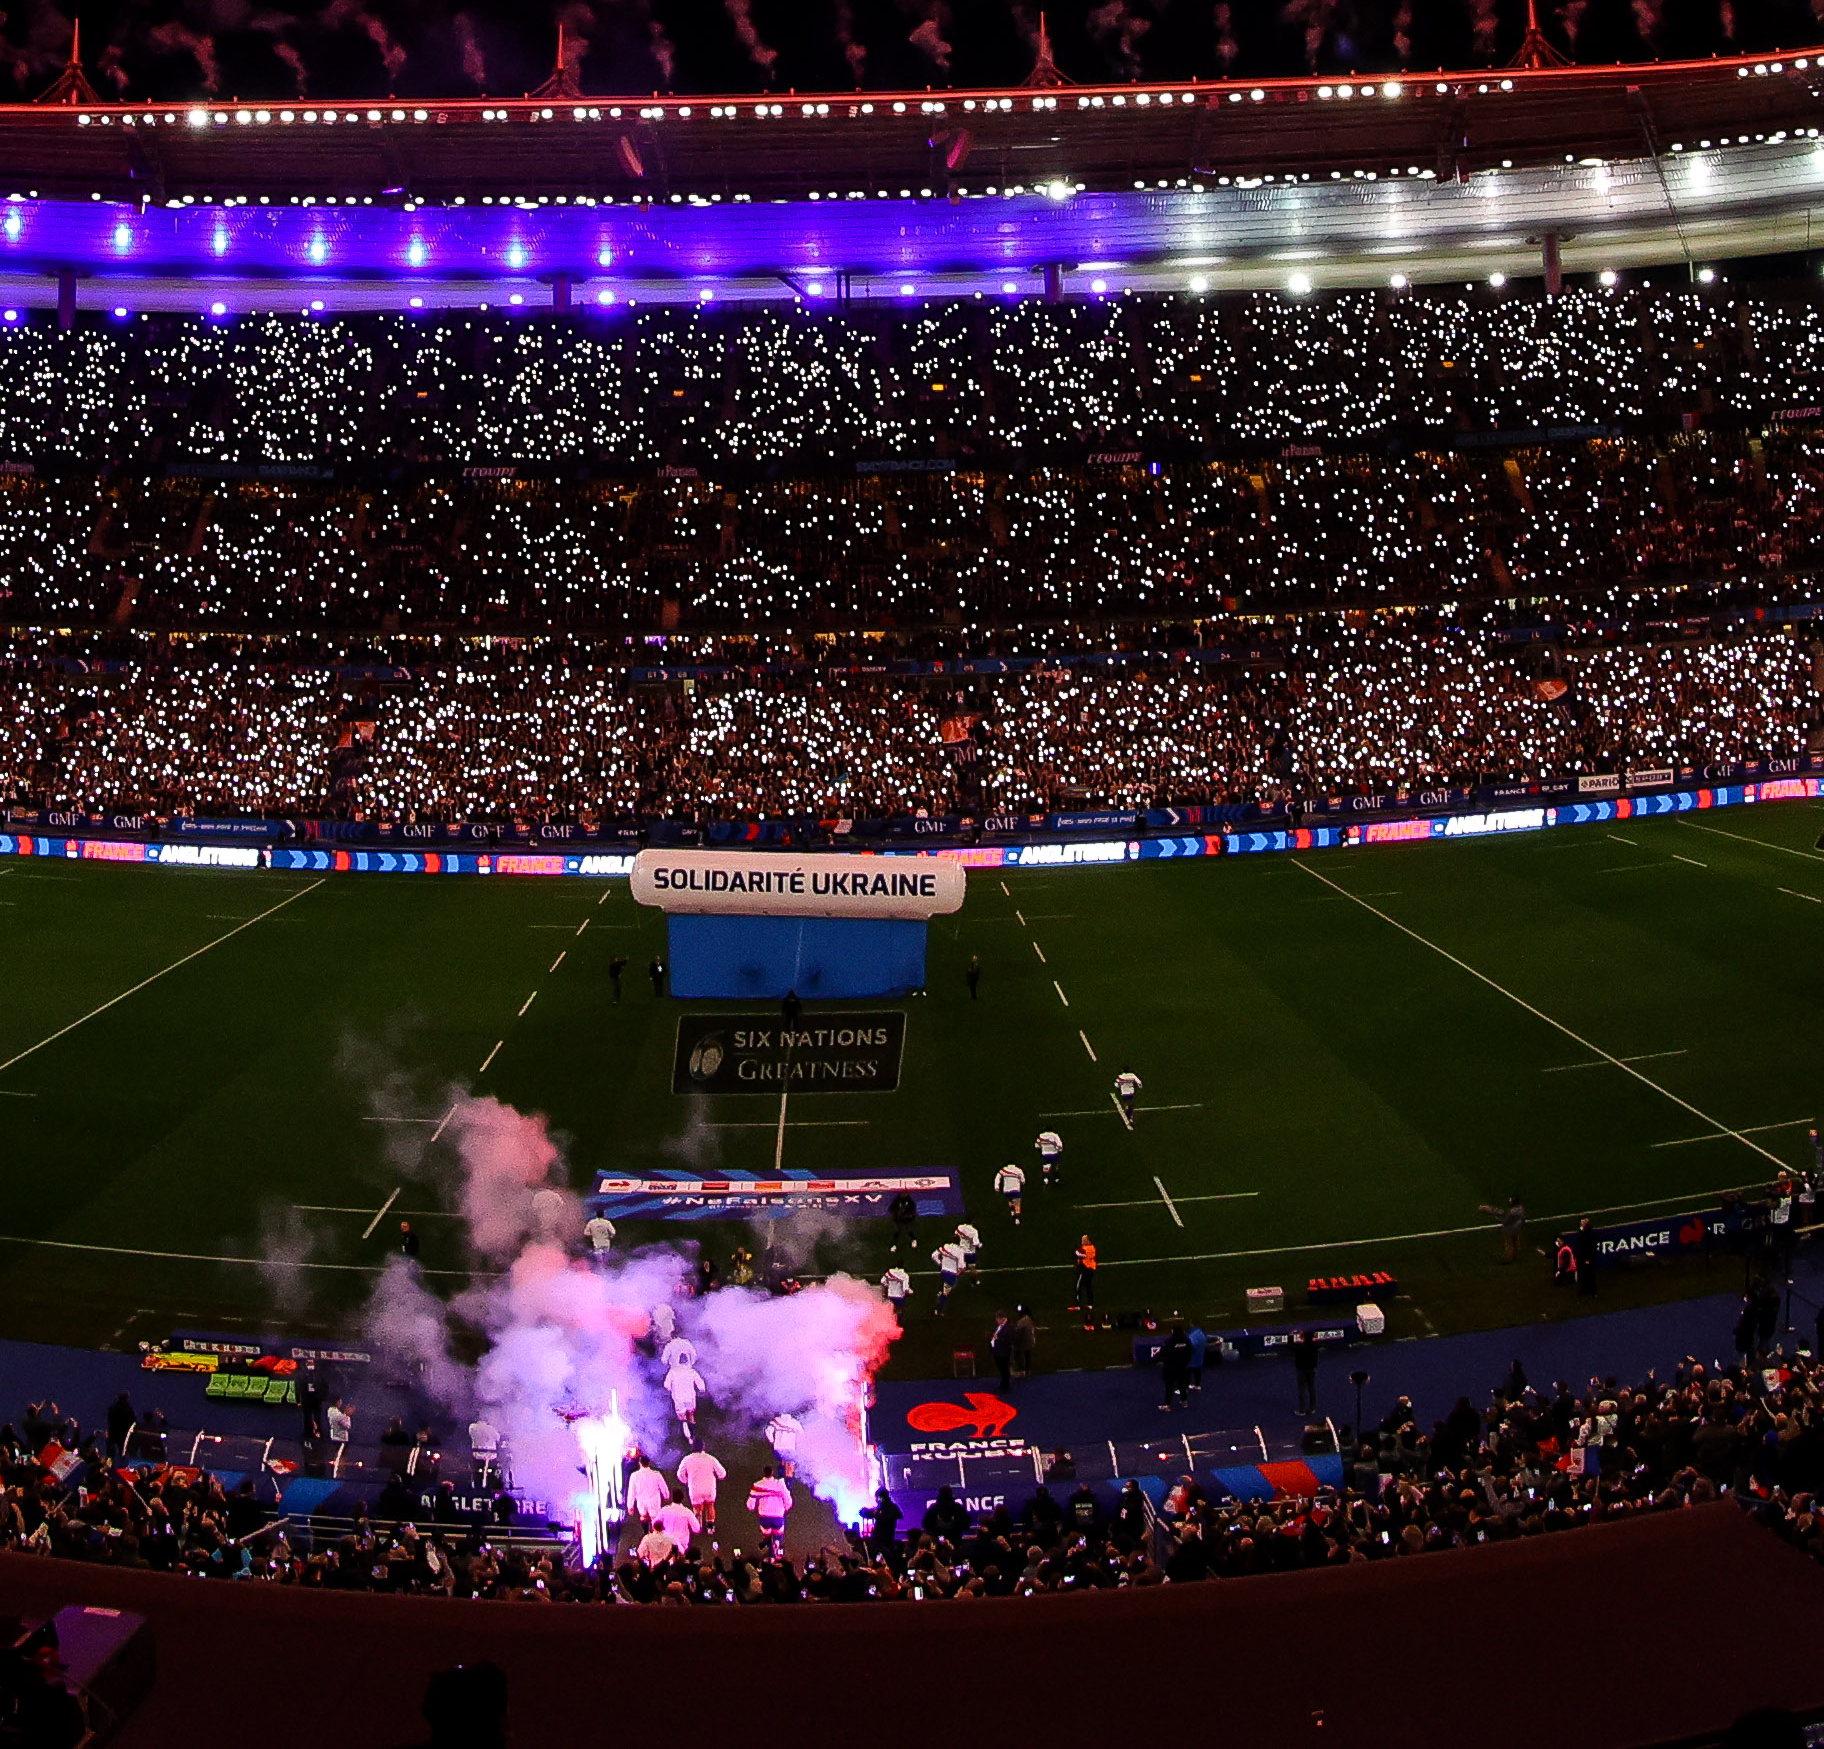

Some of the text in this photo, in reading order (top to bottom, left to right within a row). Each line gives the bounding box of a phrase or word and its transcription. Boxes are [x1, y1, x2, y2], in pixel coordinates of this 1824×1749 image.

[1770, 757, 1800, 774] GMF
[1353, 795, 1386, 811] GMF
[1420, 791, 1453, 807] GMF
[48, 812, 80, 827] GMF
[113, 815, 146, 830] GMF
[985, 817, 1019, 833] GMF
[402, 824, 435, 839] GMF
[541, 824, 575, 839] GMF
[1365, 820, 1432, 842] FRANCE
[82, 841, 145, 862] FRANCE
[496, 855, 565, 875] FRANCE
[653, 866, 936, 898] SOLIDARITÉ UKRAINE
[733, 1028, 888, 1048] SIX NATIONS
[911, 1438, 1025, 1452] FRANCE
